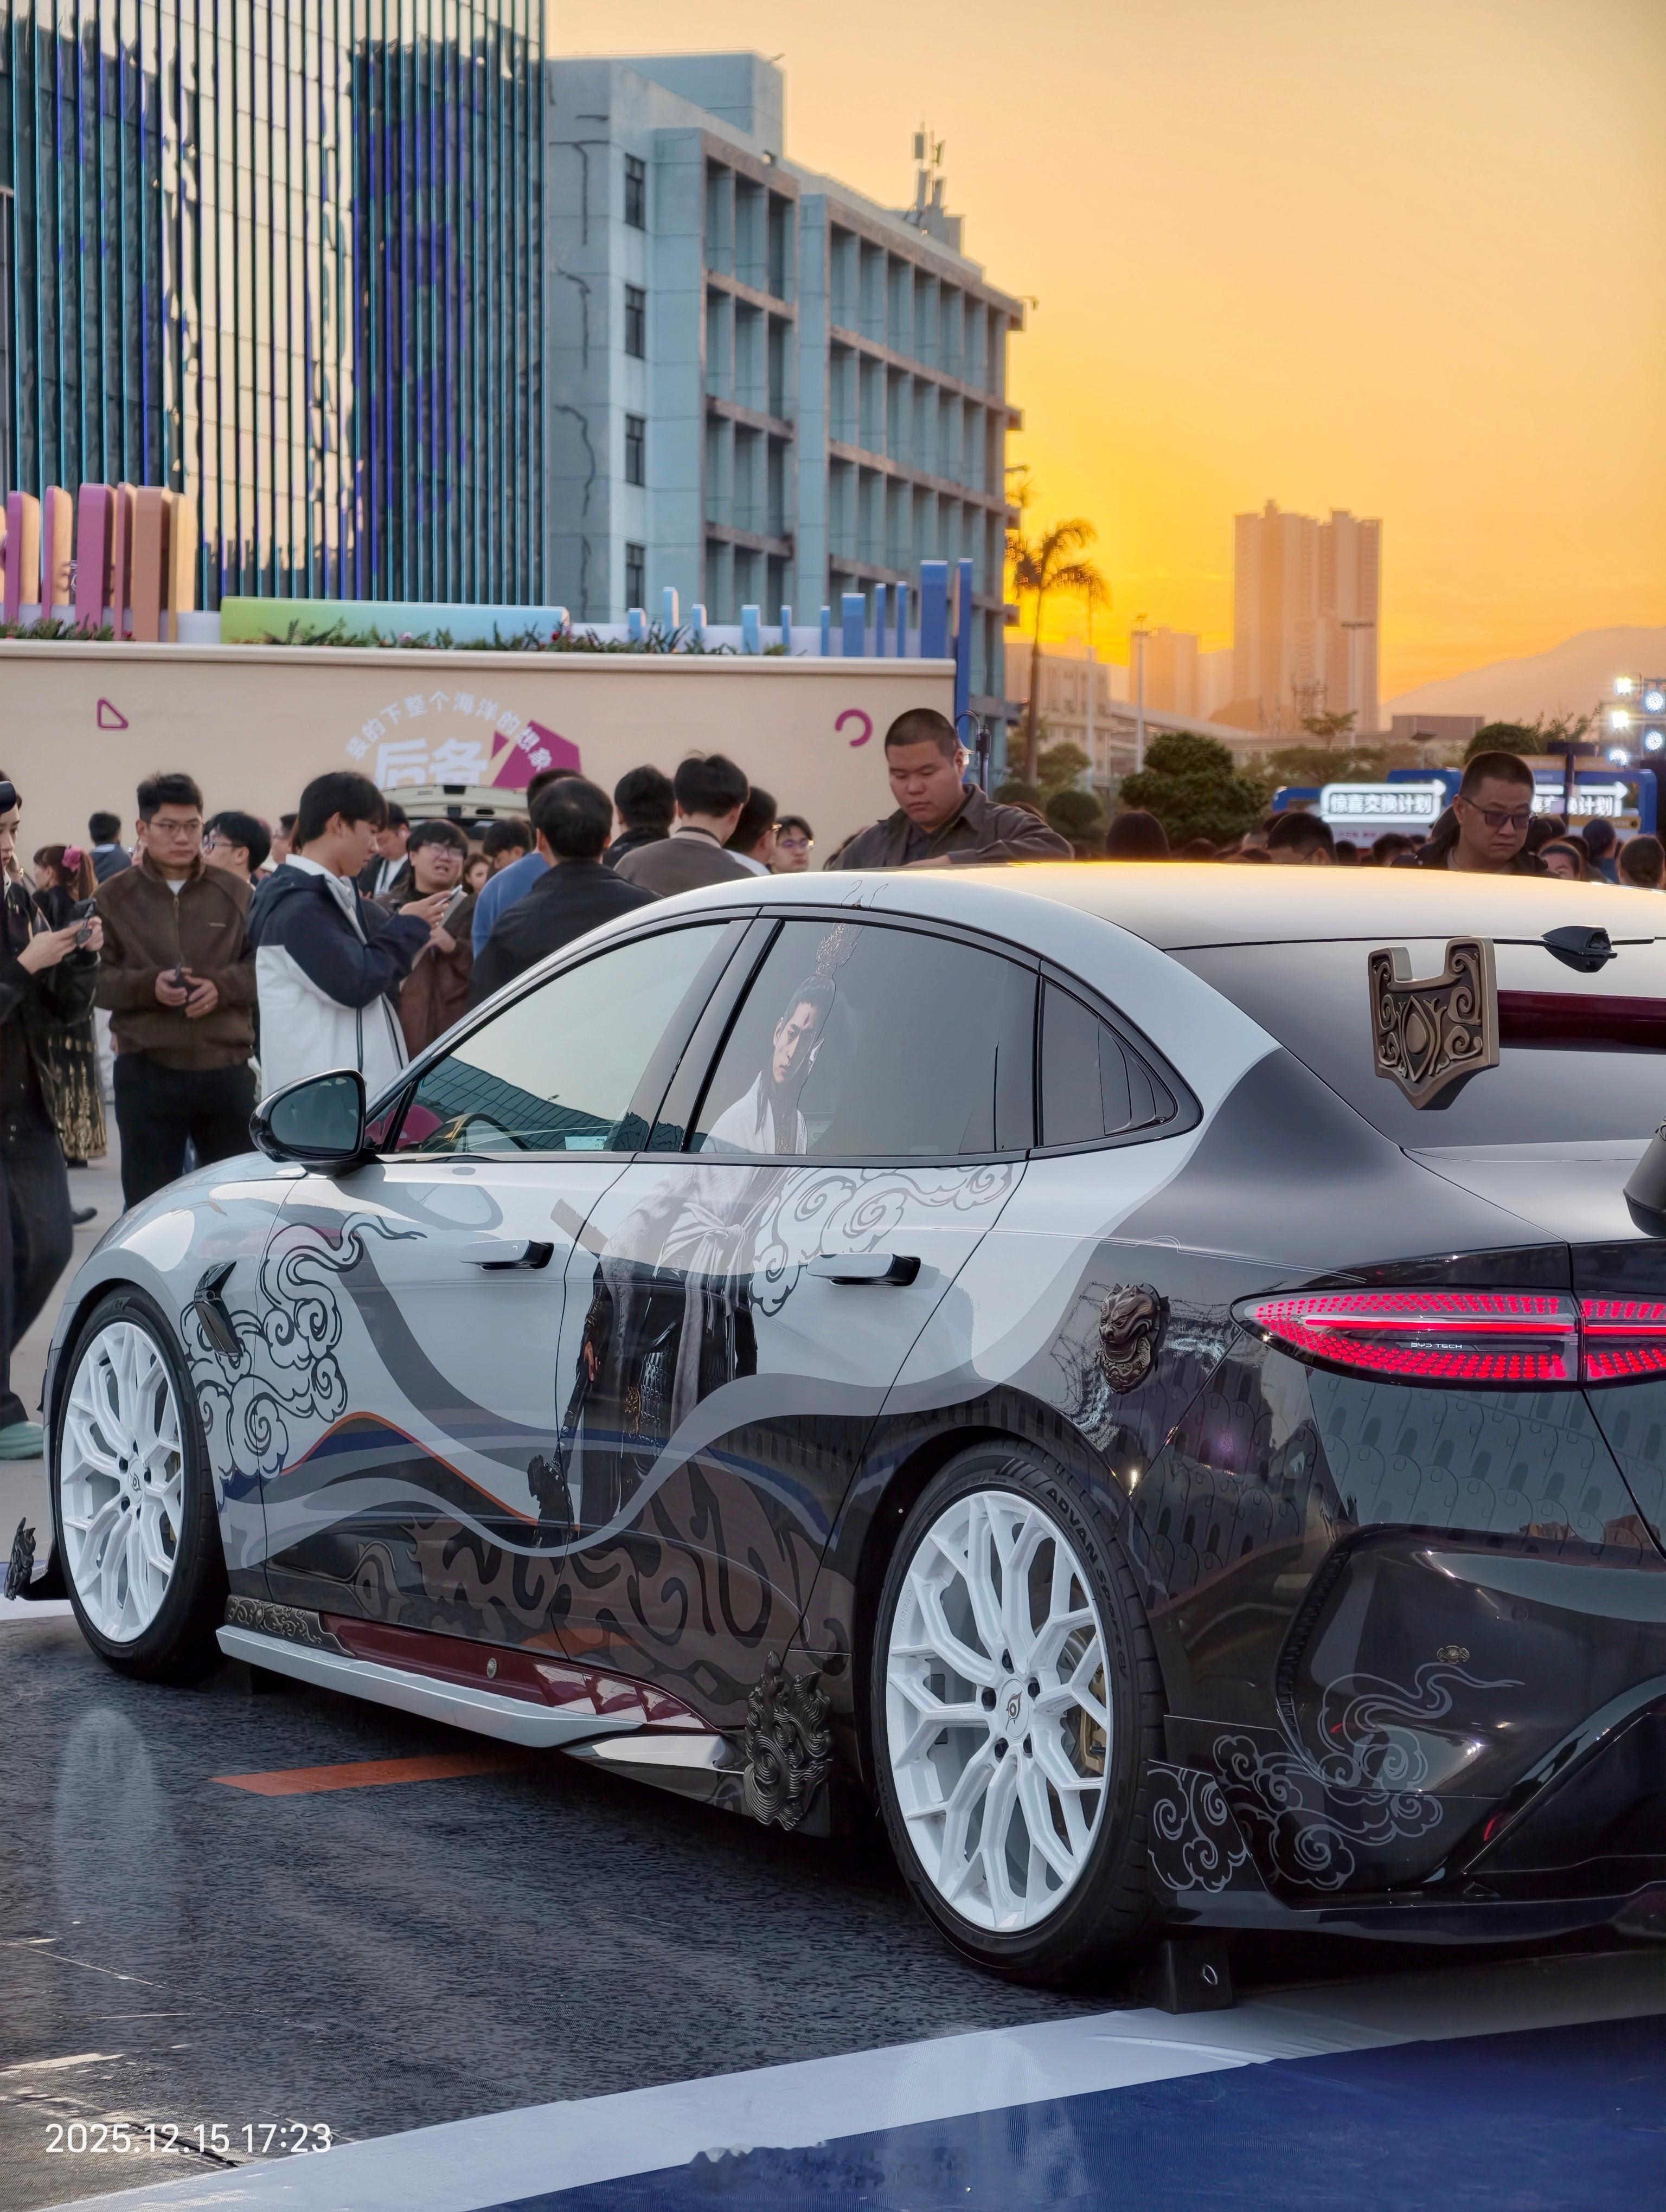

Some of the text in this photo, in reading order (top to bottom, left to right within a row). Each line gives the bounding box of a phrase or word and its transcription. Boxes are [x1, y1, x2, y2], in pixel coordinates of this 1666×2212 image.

[1330, 793, 1432, 814] 惊喜交换计划
[1046, 1487, 1098, 1564] ADVAN
